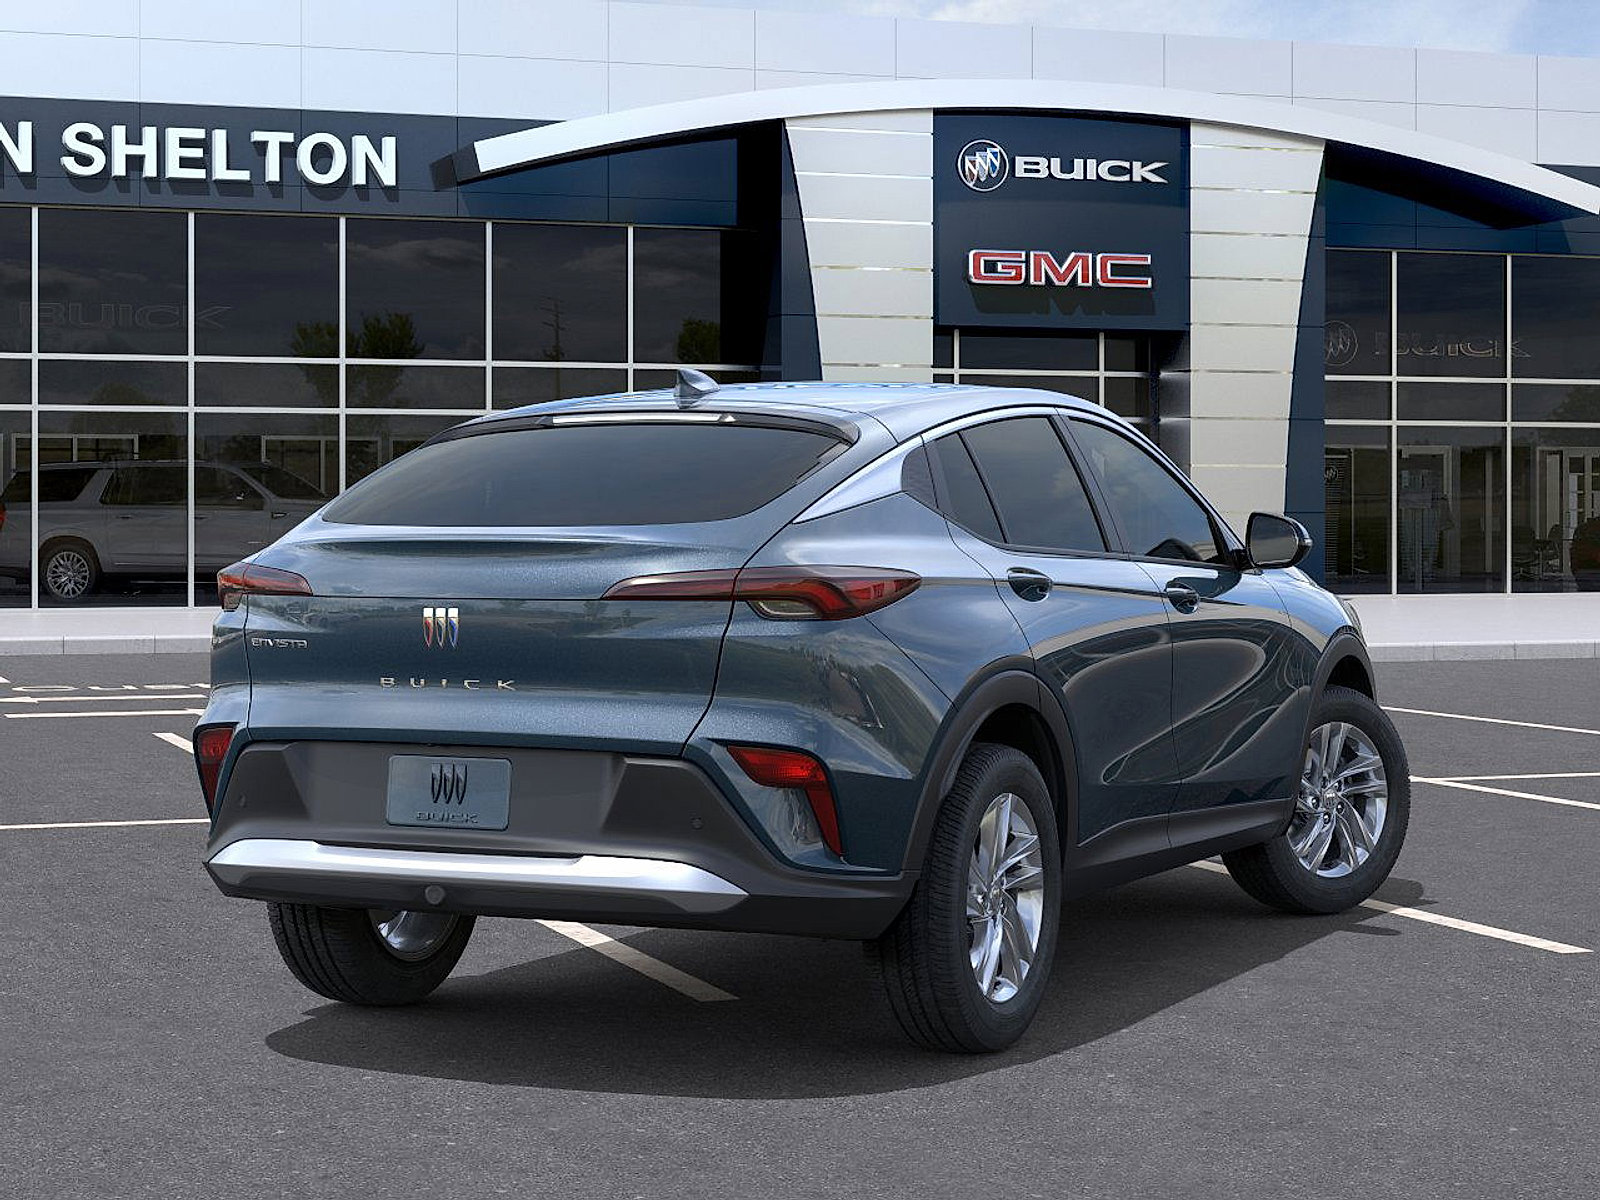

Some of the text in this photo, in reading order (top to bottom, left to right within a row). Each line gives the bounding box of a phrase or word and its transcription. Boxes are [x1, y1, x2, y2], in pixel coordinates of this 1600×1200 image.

[60, 121, 397, 187] SHELTON
[1014, 155, 1169, 183] BUICK
[968, 249, 1153, 289] GMC
[380, 677, 516, 691] BUICK
[417, 810, 479, 824] BUICK
